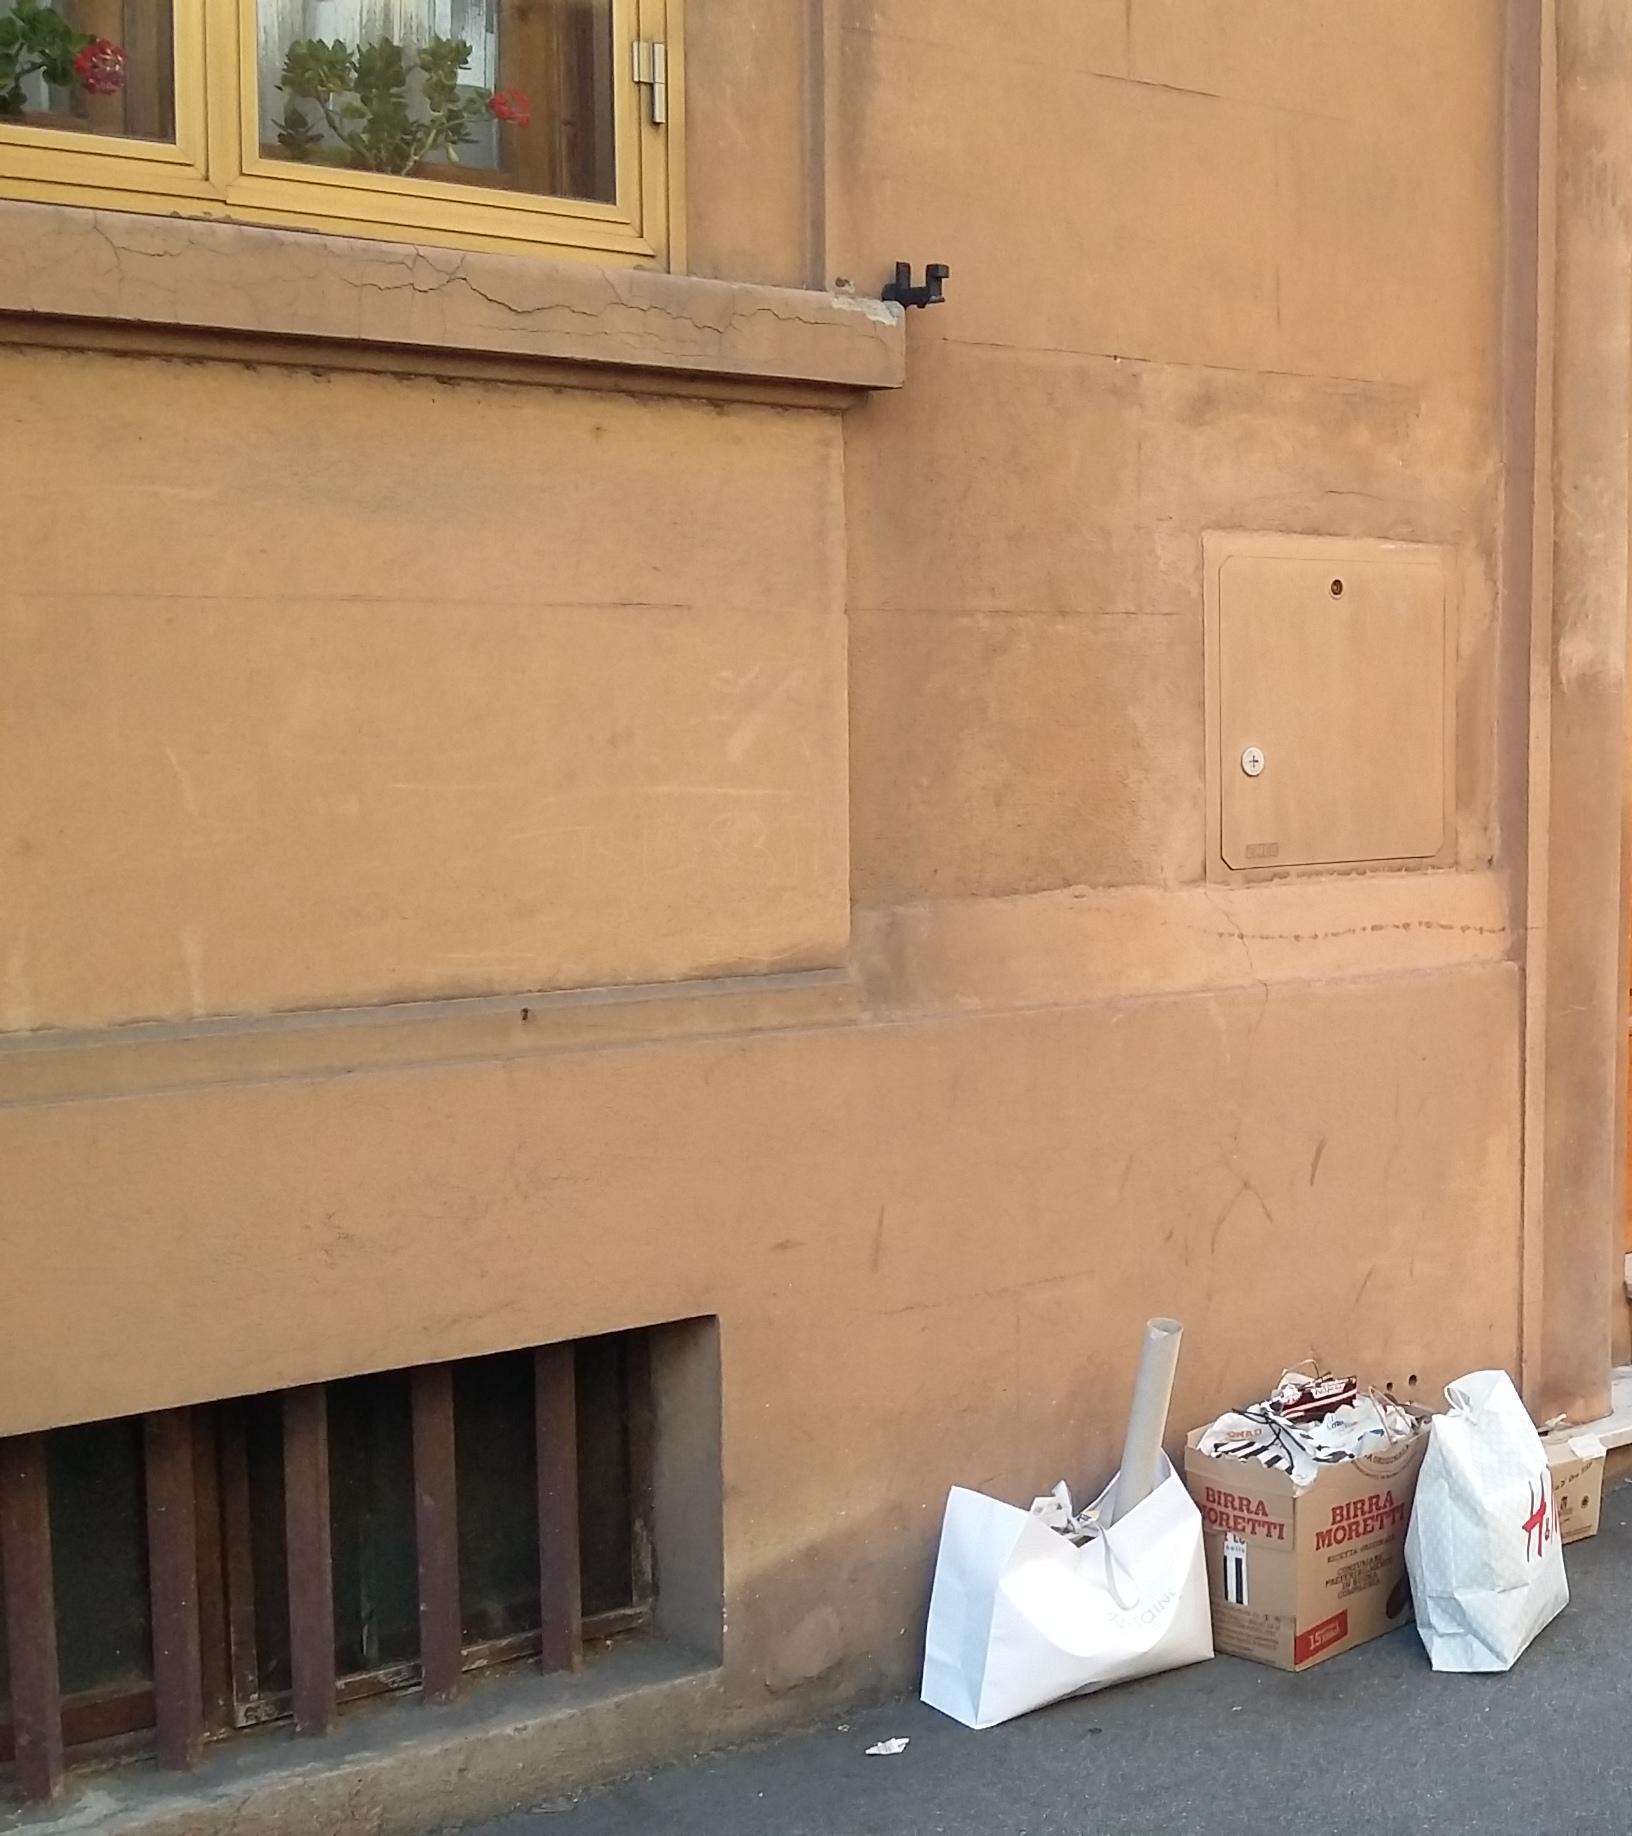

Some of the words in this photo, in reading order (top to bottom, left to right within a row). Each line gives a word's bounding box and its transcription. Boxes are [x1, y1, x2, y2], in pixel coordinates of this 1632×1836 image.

[1205, 1487, 1268, 1517] BIRRA
[1331, 1490, 1394, 1526] BIRRA
[1315, 1502, 1405, 1551] MORETTI
[1309, 1631, 1323, 1651] 15
